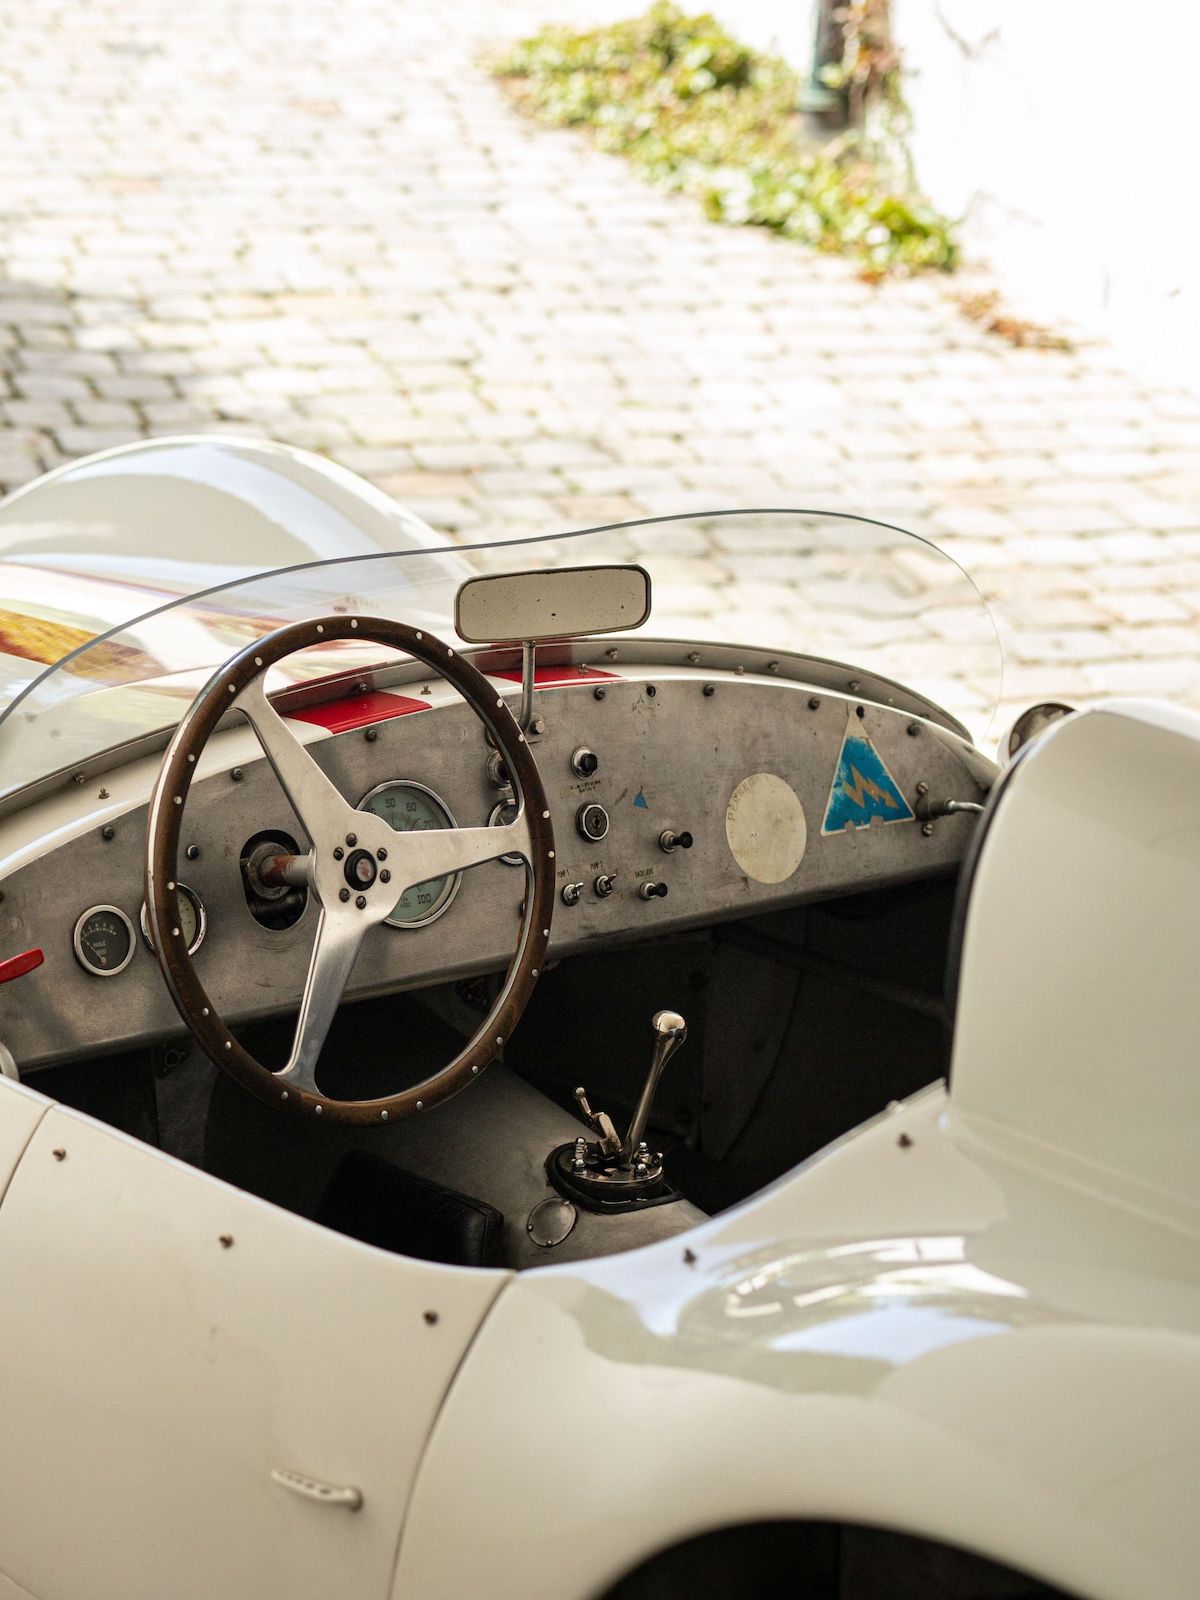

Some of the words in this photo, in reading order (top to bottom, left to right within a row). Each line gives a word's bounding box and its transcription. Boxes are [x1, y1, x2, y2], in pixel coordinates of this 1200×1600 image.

[385, 798, 396, 808] 50
[406, 802, 417, 811] 60
[417, 894, 431, 904] 100
